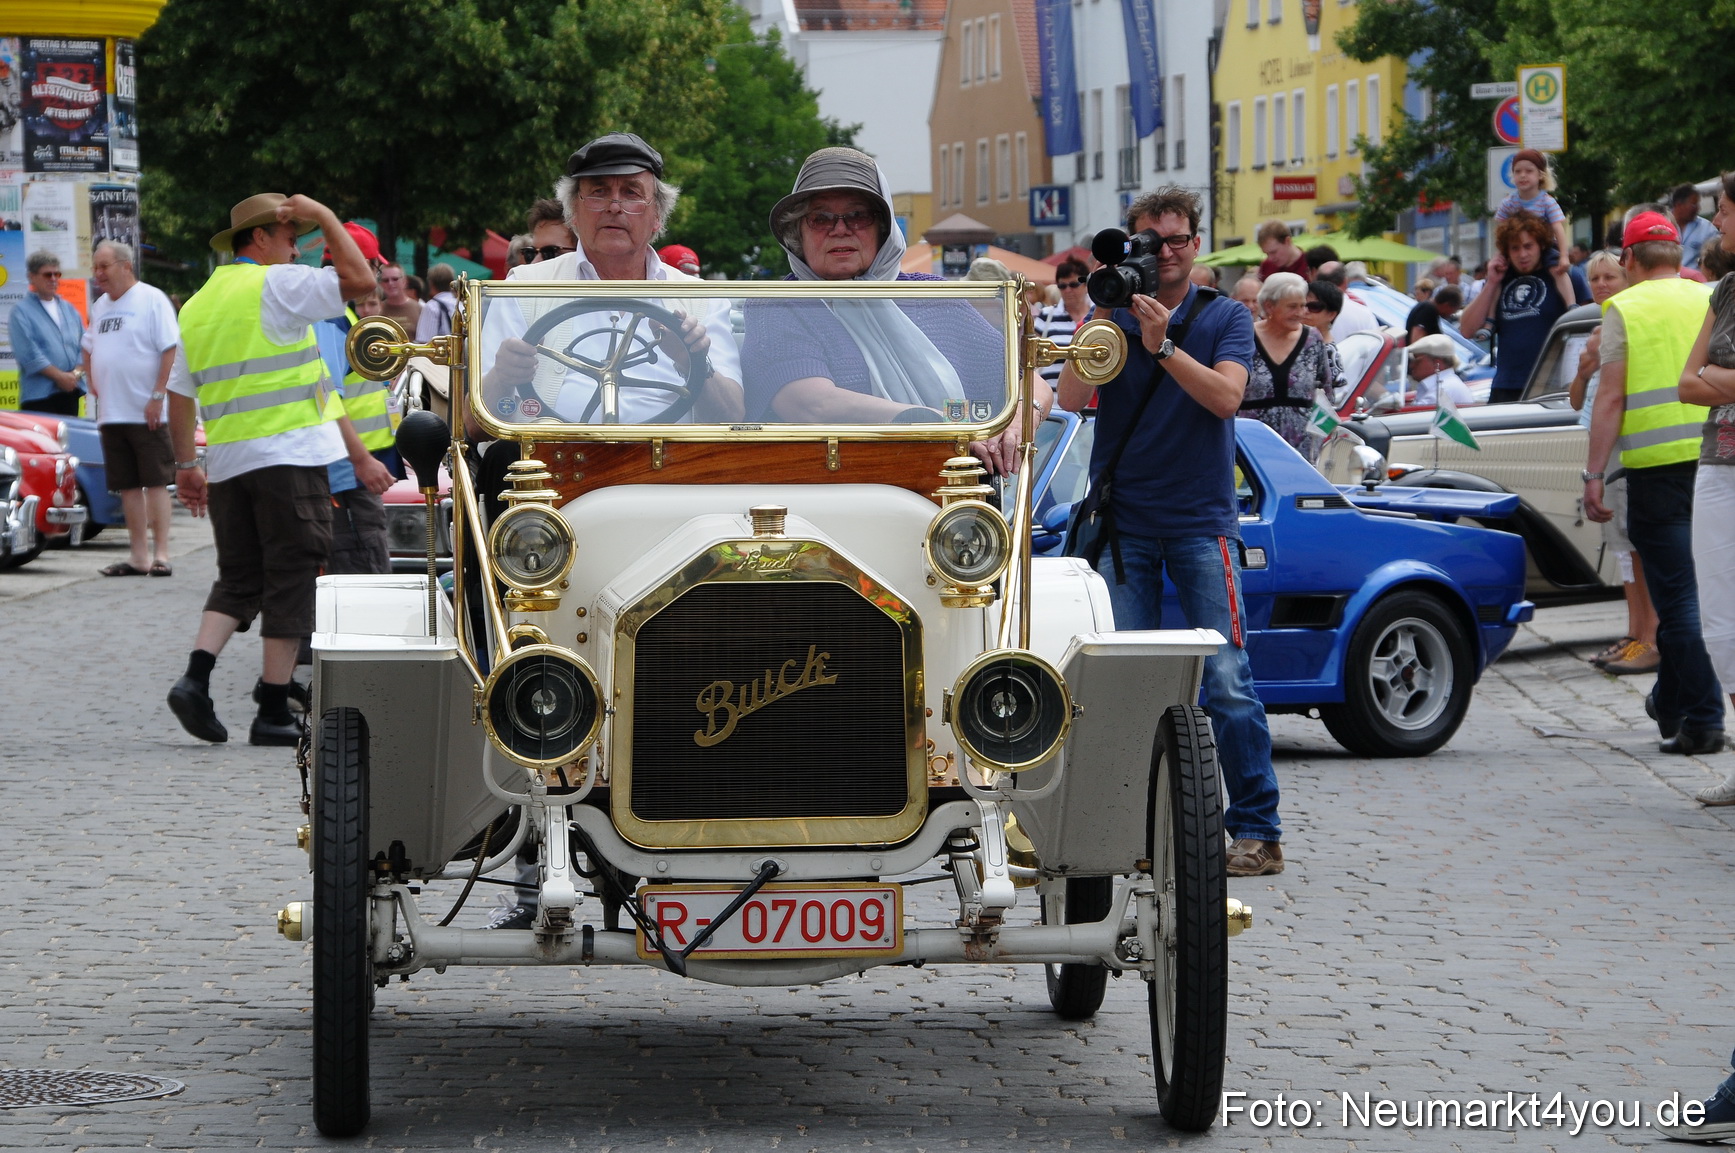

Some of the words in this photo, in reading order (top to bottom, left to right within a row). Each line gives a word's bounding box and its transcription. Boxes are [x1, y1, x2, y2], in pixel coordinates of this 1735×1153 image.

[29, 39, 60, 49] FREITAG
[60, 40, 67, 49] &
[67, 40, 99, 50] SAMSTAG
[1259, 58, 1283, 87] HOTEL
[31, 83, 101, 104] ALTSTADTFEST
[1534, 80, 1550, 97] H
[44, 106, 69, 119] AFTER
[68, 107, 91, 120] PARTY
[694, 645, 838, 747] Buick
[742, 898, 885, 944] 07009
